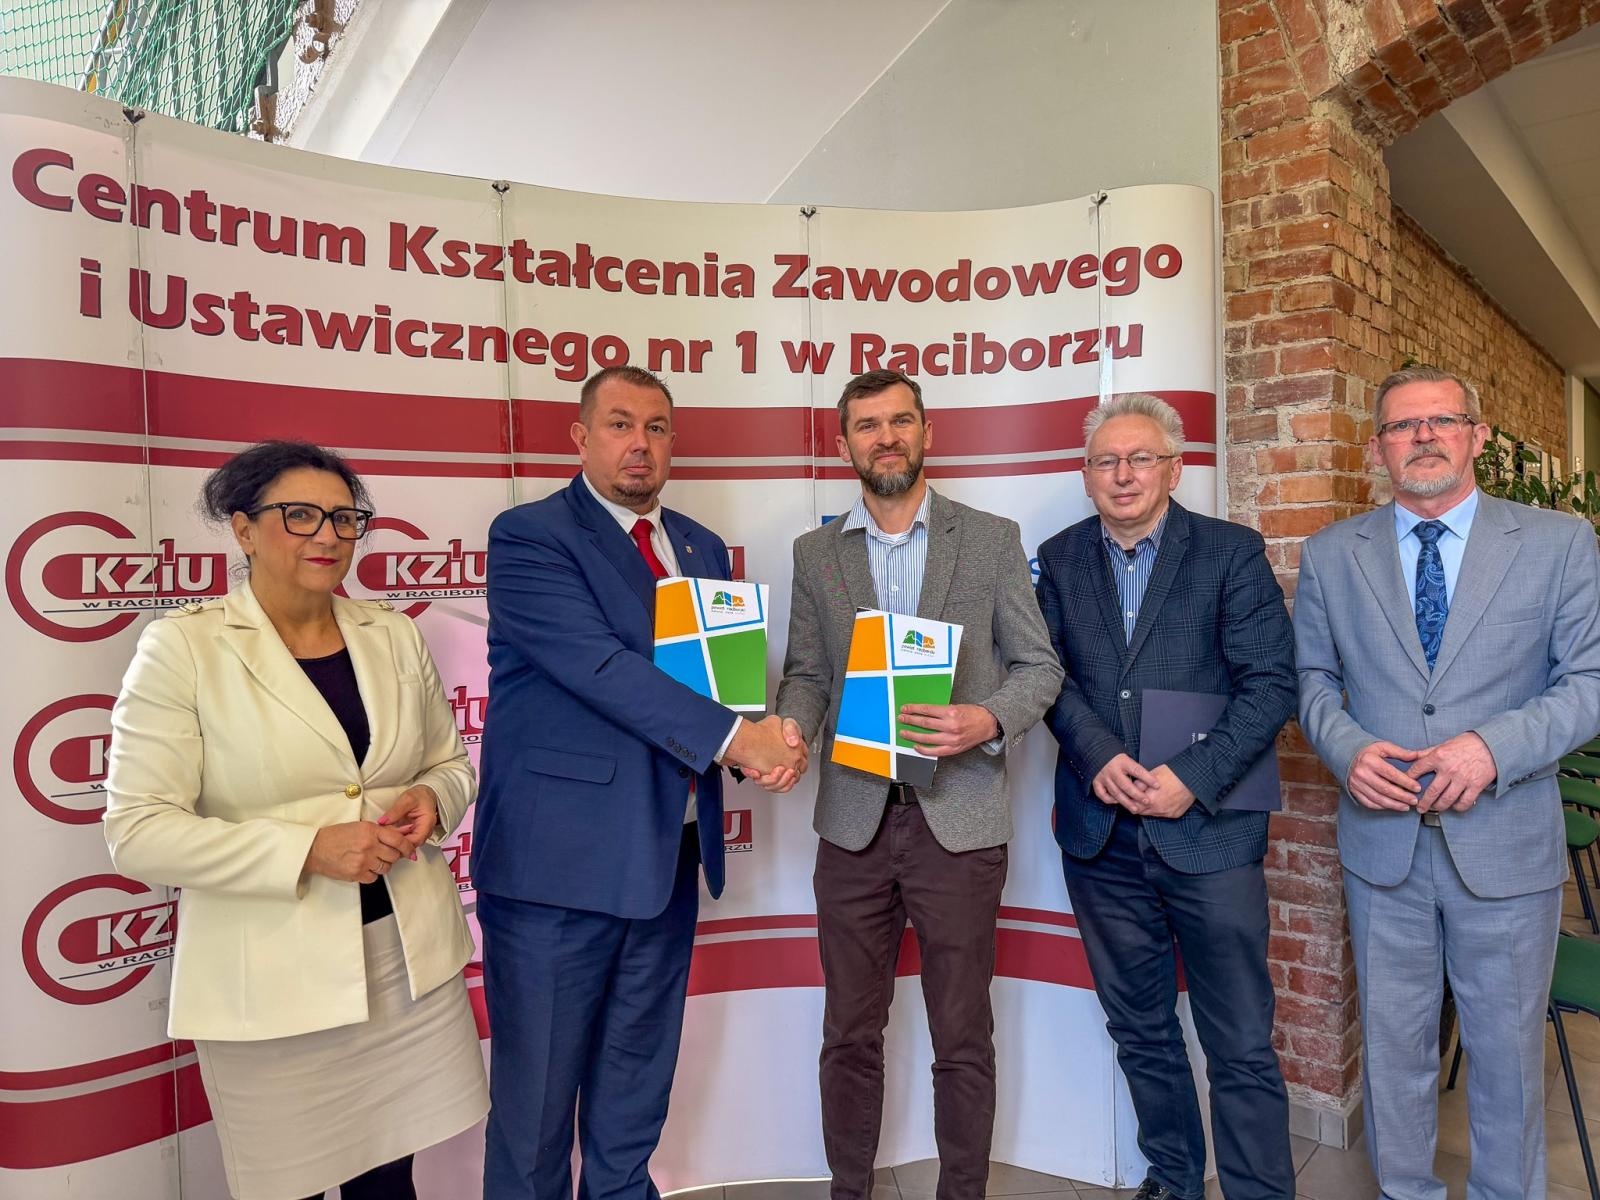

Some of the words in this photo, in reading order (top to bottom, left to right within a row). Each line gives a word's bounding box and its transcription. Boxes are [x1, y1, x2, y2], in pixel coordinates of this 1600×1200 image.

[12, 148, 366, 267] Centrum
[388, 221, 755, 299] Kształcenia
[772, 243, 1183, 302] Zawodowego
[79, 257, 102, 319] i
[128, 267, 630, 383] Ustawicznego
[647, 338, 713, 373] nr
[735, 330, 758, 374] 1
[780, 340, 835, 375] w
[849, 321, 1143, 377] Raciborzu
[108, 596, 220, 608] RACIBOR
[406, 588, 488, 598] RACIBOR
